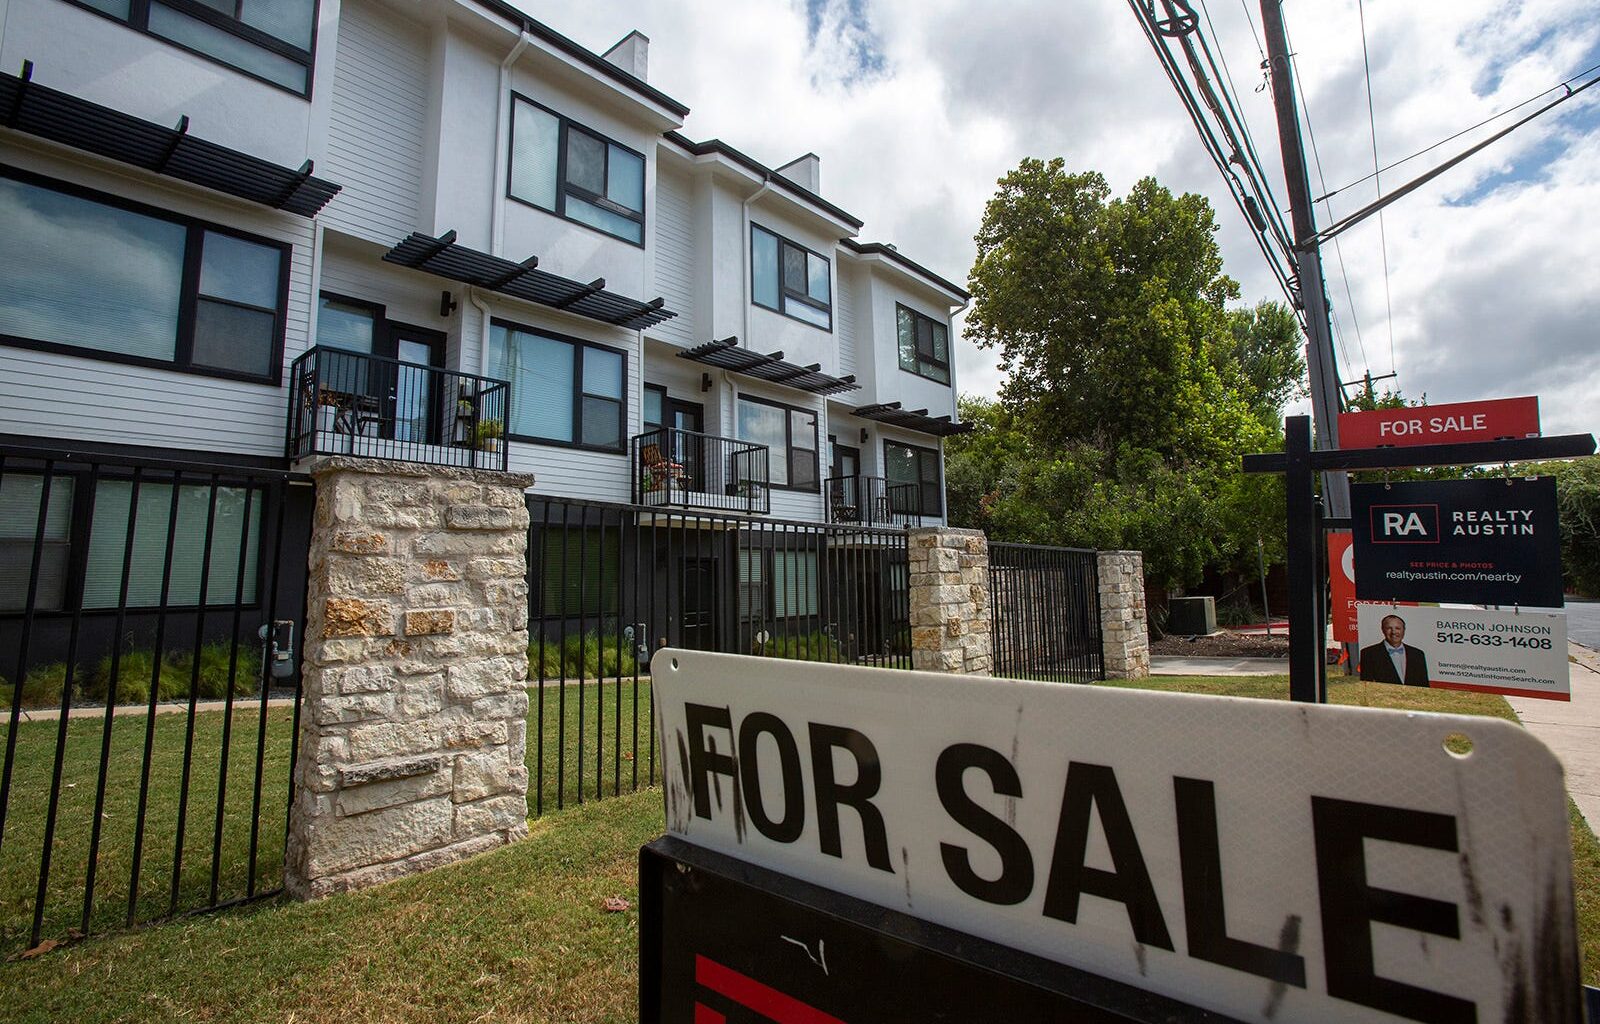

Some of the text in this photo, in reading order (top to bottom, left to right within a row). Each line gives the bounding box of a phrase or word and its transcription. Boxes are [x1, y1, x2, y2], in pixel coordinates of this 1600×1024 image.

[1380, 414, 1487, 437] FOR SALE
[1452, 509, 1534, 522] REALTY
[1383, 512, 1428, 536] RA
[1452, 524, 1534, 536] AUSTIN
[1386, 571, 1521, 583] realtyaustin.com/nearby
[1436, 620, 1551, 635] BARRON JOHNSON
[1437, 632, 1552, 650] 512-633-1408
[1438, 662, 1526, 674] barron@realtyaustin.com
[1438, 671, 1555, 685] www.512AustinHomeSearch.com
[685, 702, 1478, 1024] FOR SALE
